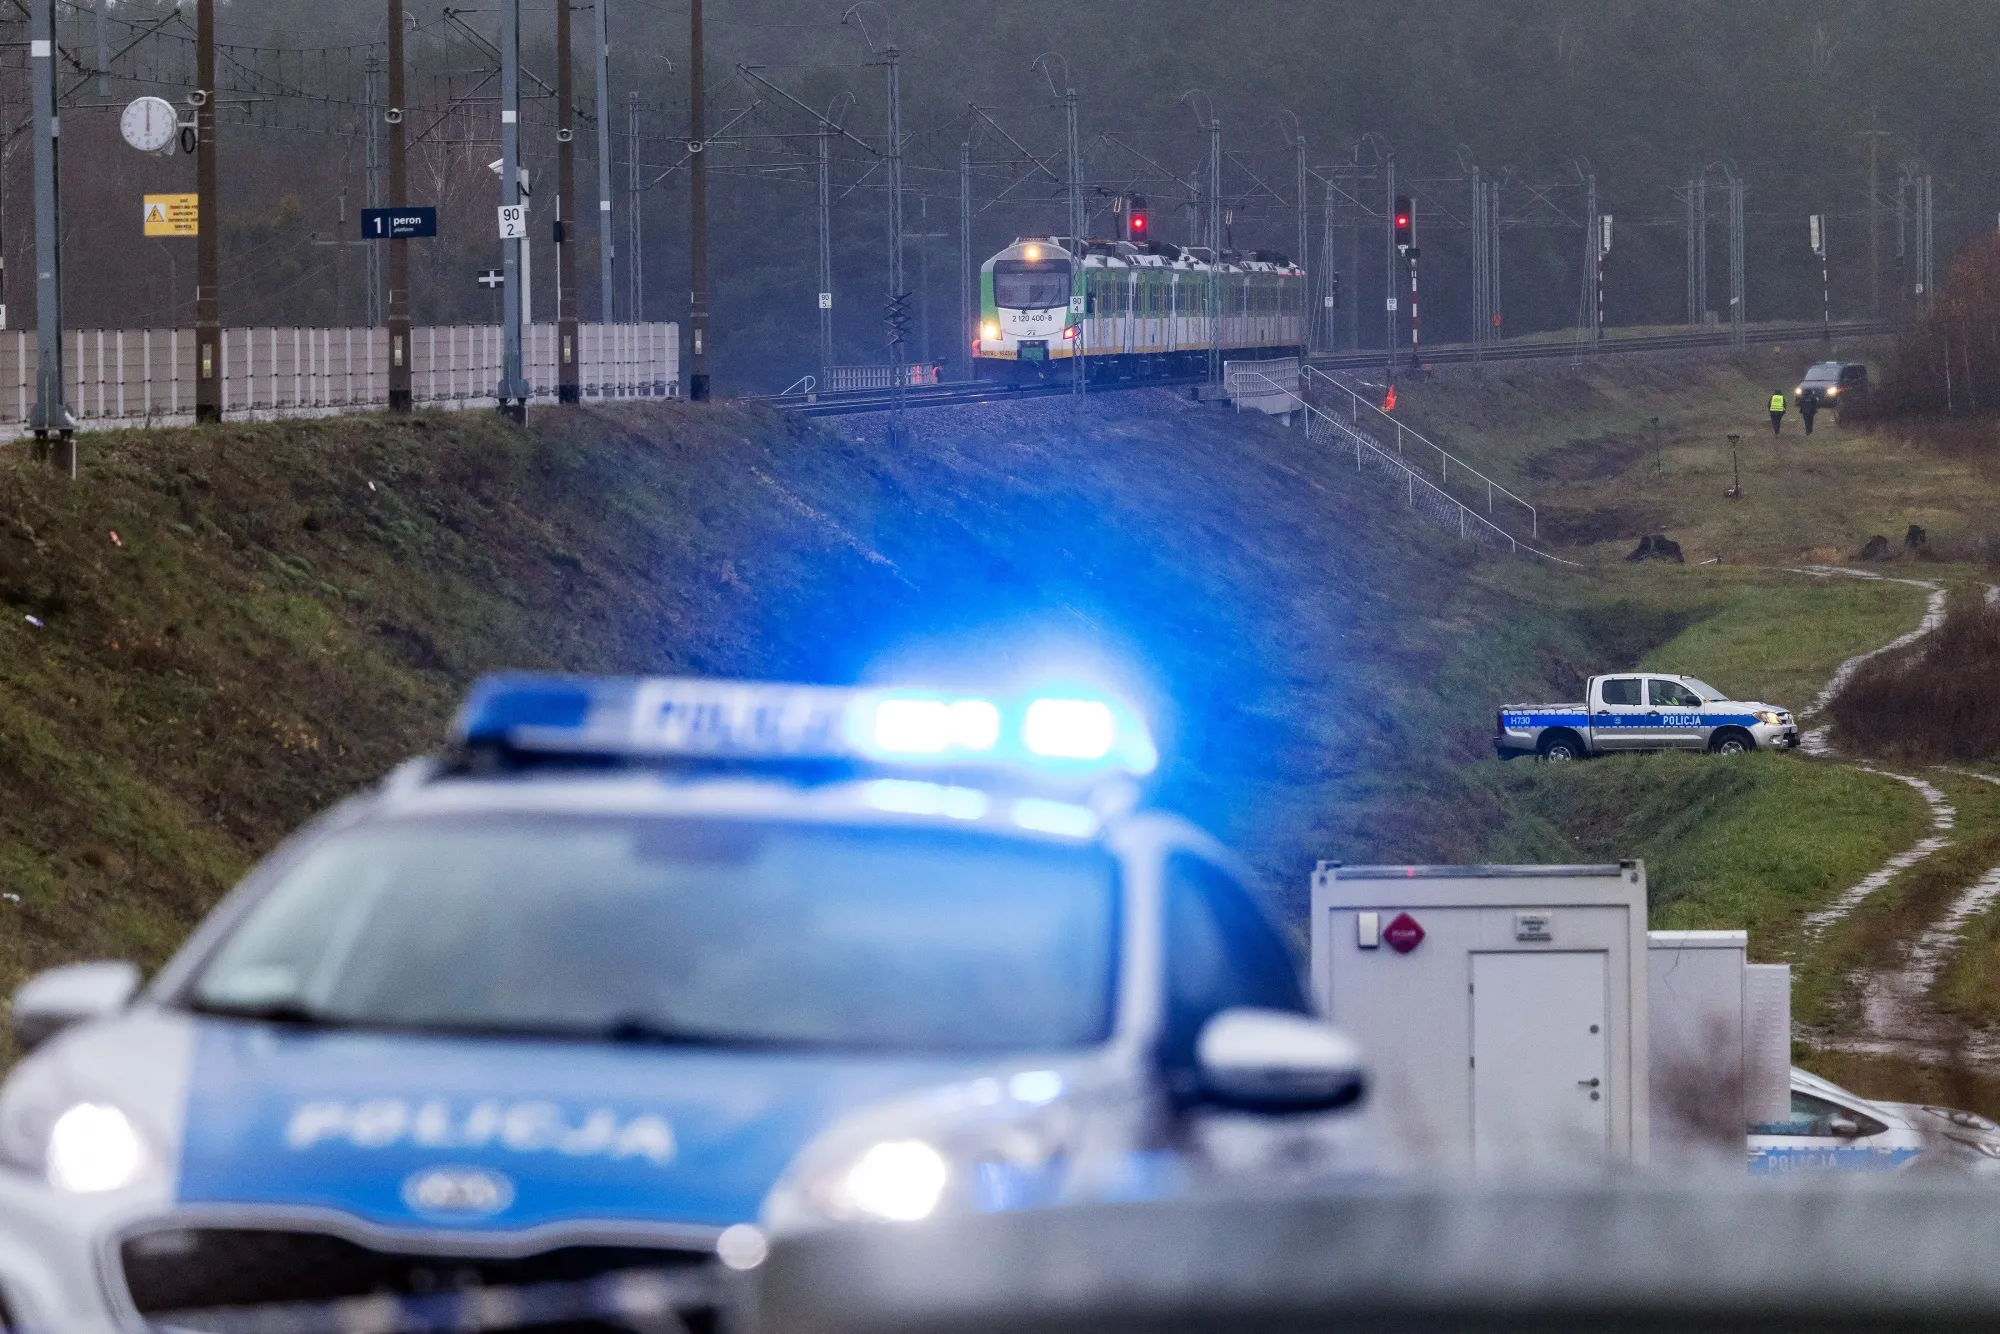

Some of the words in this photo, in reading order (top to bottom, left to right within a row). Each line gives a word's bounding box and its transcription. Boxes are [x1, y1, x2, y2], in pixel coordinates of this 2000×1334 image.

[503, 208, 520, 221] 90
[373, 217, 382, 234] 1
[393, 217, 422, 227] peron
[506, 223, 515, 236] 2
[1031, 314, 1053, 322] 400-8
[1510, 716, 1531, 725] H730
[1663, 716, 1701, 726] POLICJA
[284, 1101, 677, 1168] POLICJA
